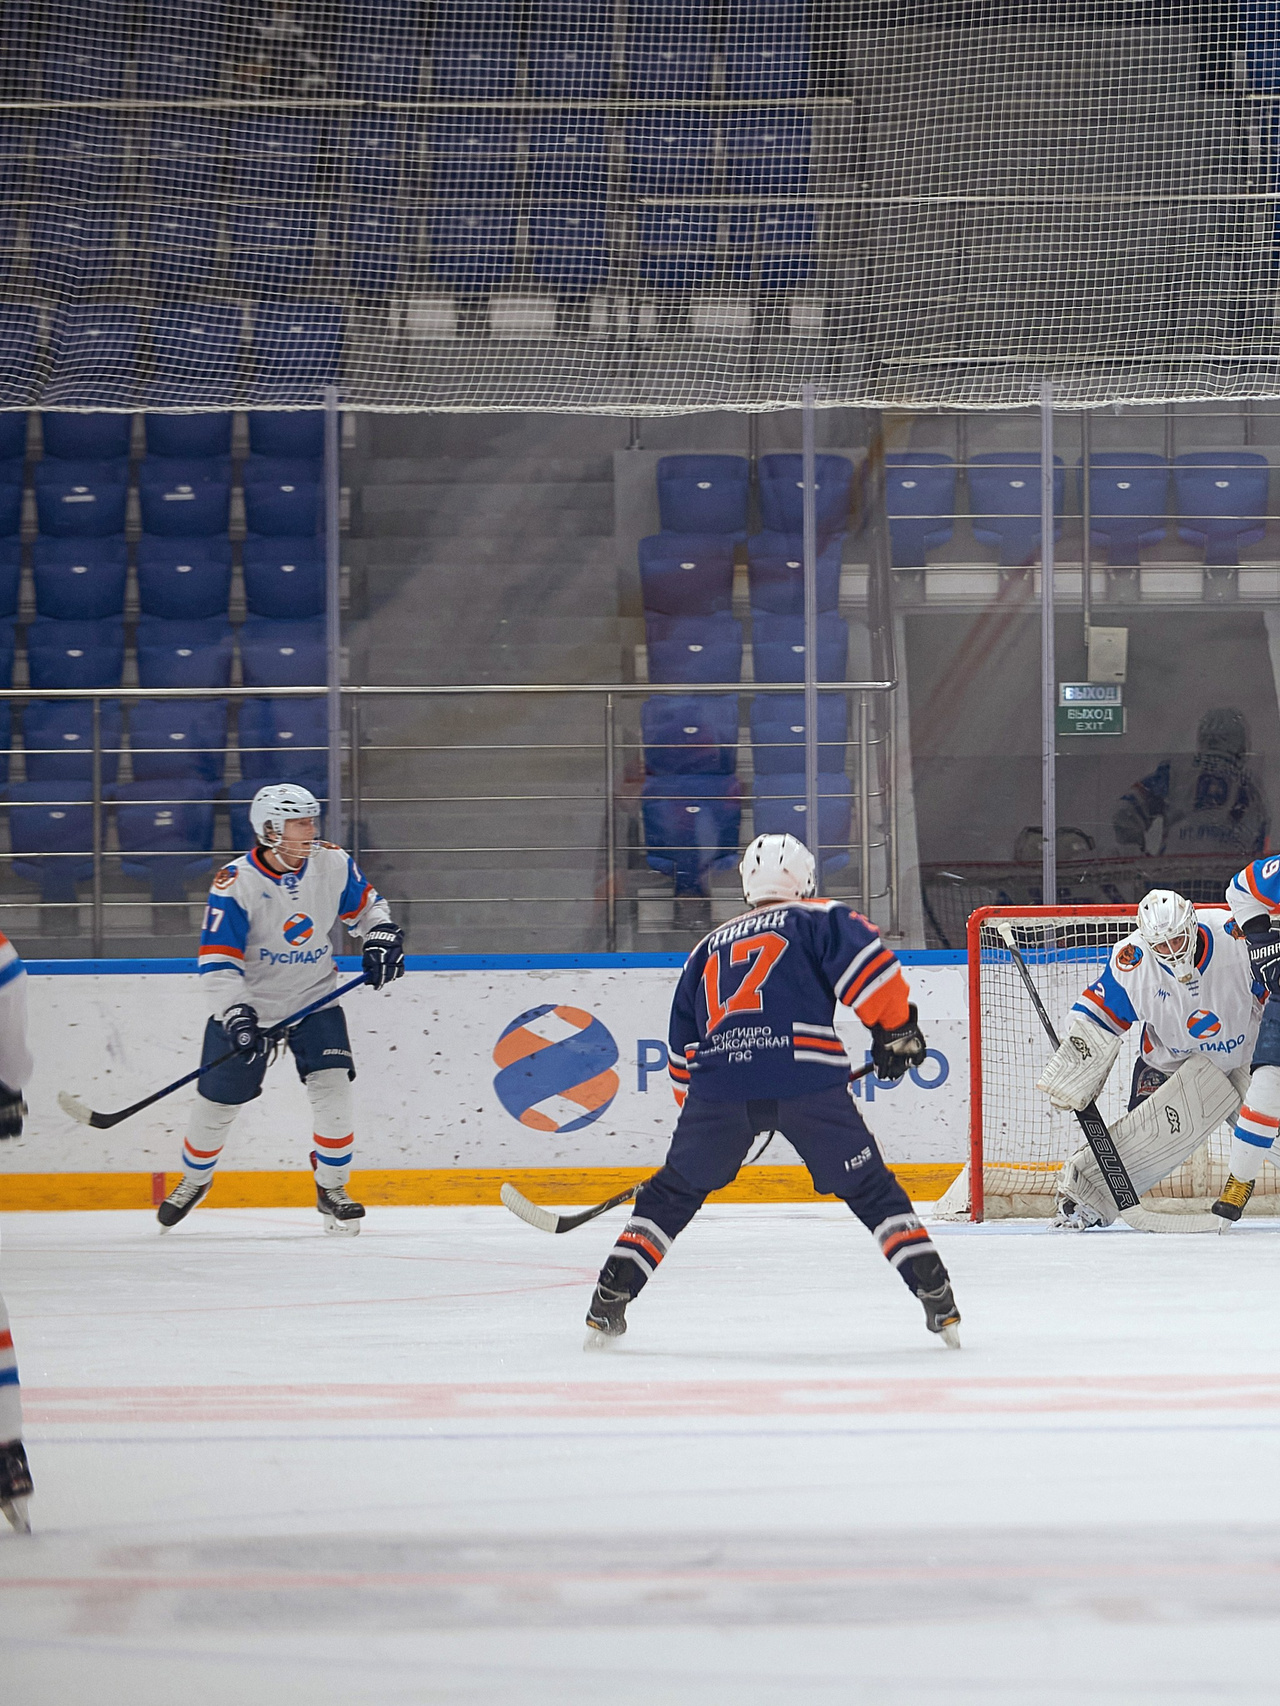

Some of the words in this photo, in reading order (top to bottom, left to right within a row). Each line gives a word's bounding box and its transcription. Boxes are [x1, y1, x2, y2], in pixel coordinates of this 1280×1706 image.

[1067, 708, 1114, 721] ВЫХОД
[1075, 721, 1105, 731] EXIT
[259, 944, 329, 966] РусГидро
[701, 930, 789, 1039] 17
[699, 1035, 789, 1056] ОКСАРСКАЯ
[727, 1050, 753, 1063] ГЭС
